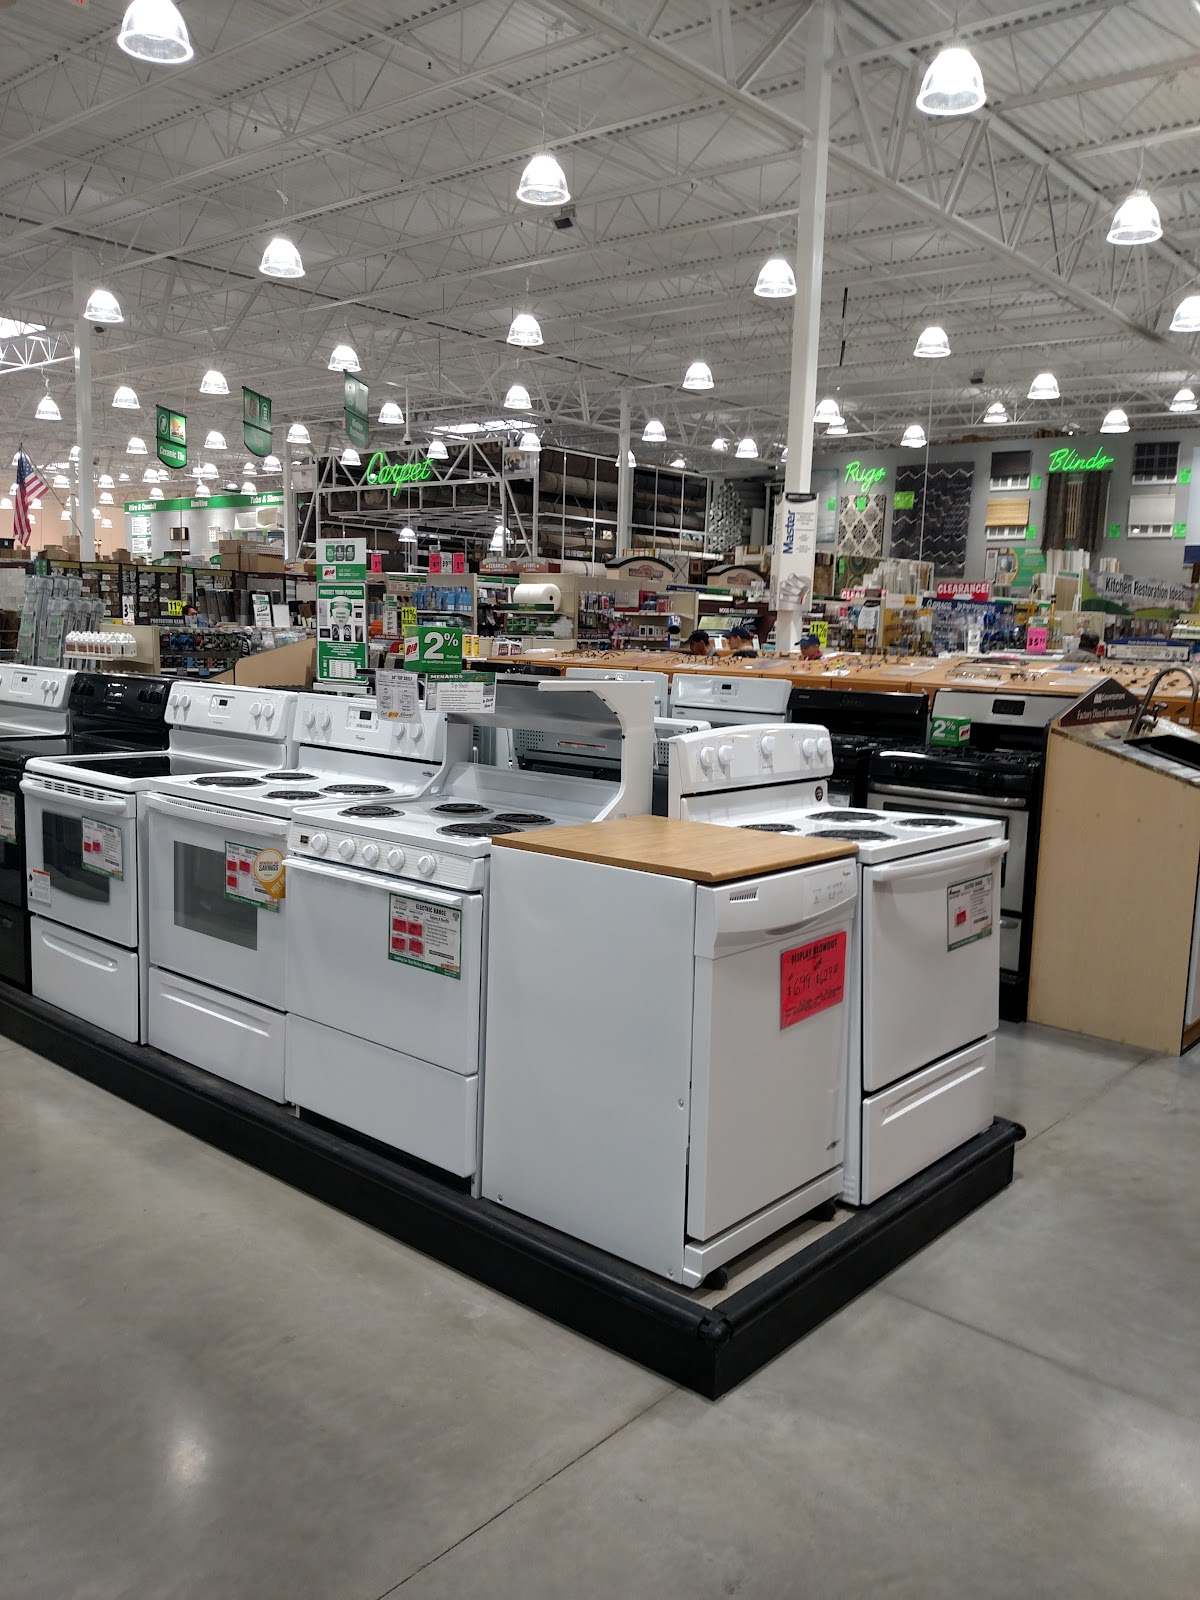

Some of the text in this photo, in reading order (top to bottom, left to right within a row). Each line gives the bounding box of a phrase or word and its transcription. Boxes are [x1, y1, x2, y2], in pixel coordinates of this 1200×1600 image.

[159, 446, 177, 459] Ceramic
[1048, 446, 1114, 472] Blinds
[366, 449, 432, 497] Carpet
[844, 460, 887, 492] Rugs
[782, 510, 796, 554] Master
[937, 583, 990, 594] CLEARANCE!
[1105, 577, 1132, 594] Kitchen
[1133, 580, 1169, 599] Restoration
[423, 632, 459, 660] 2%
[932, 720, 956, 738] 2%
[415, 903, 433, 913] ELECTRIC
[433, 908, 447, 917] RANGE
[791, 949, 812, 965] DISPLAY
[812, 938, 838, 955] BLOWOUT
